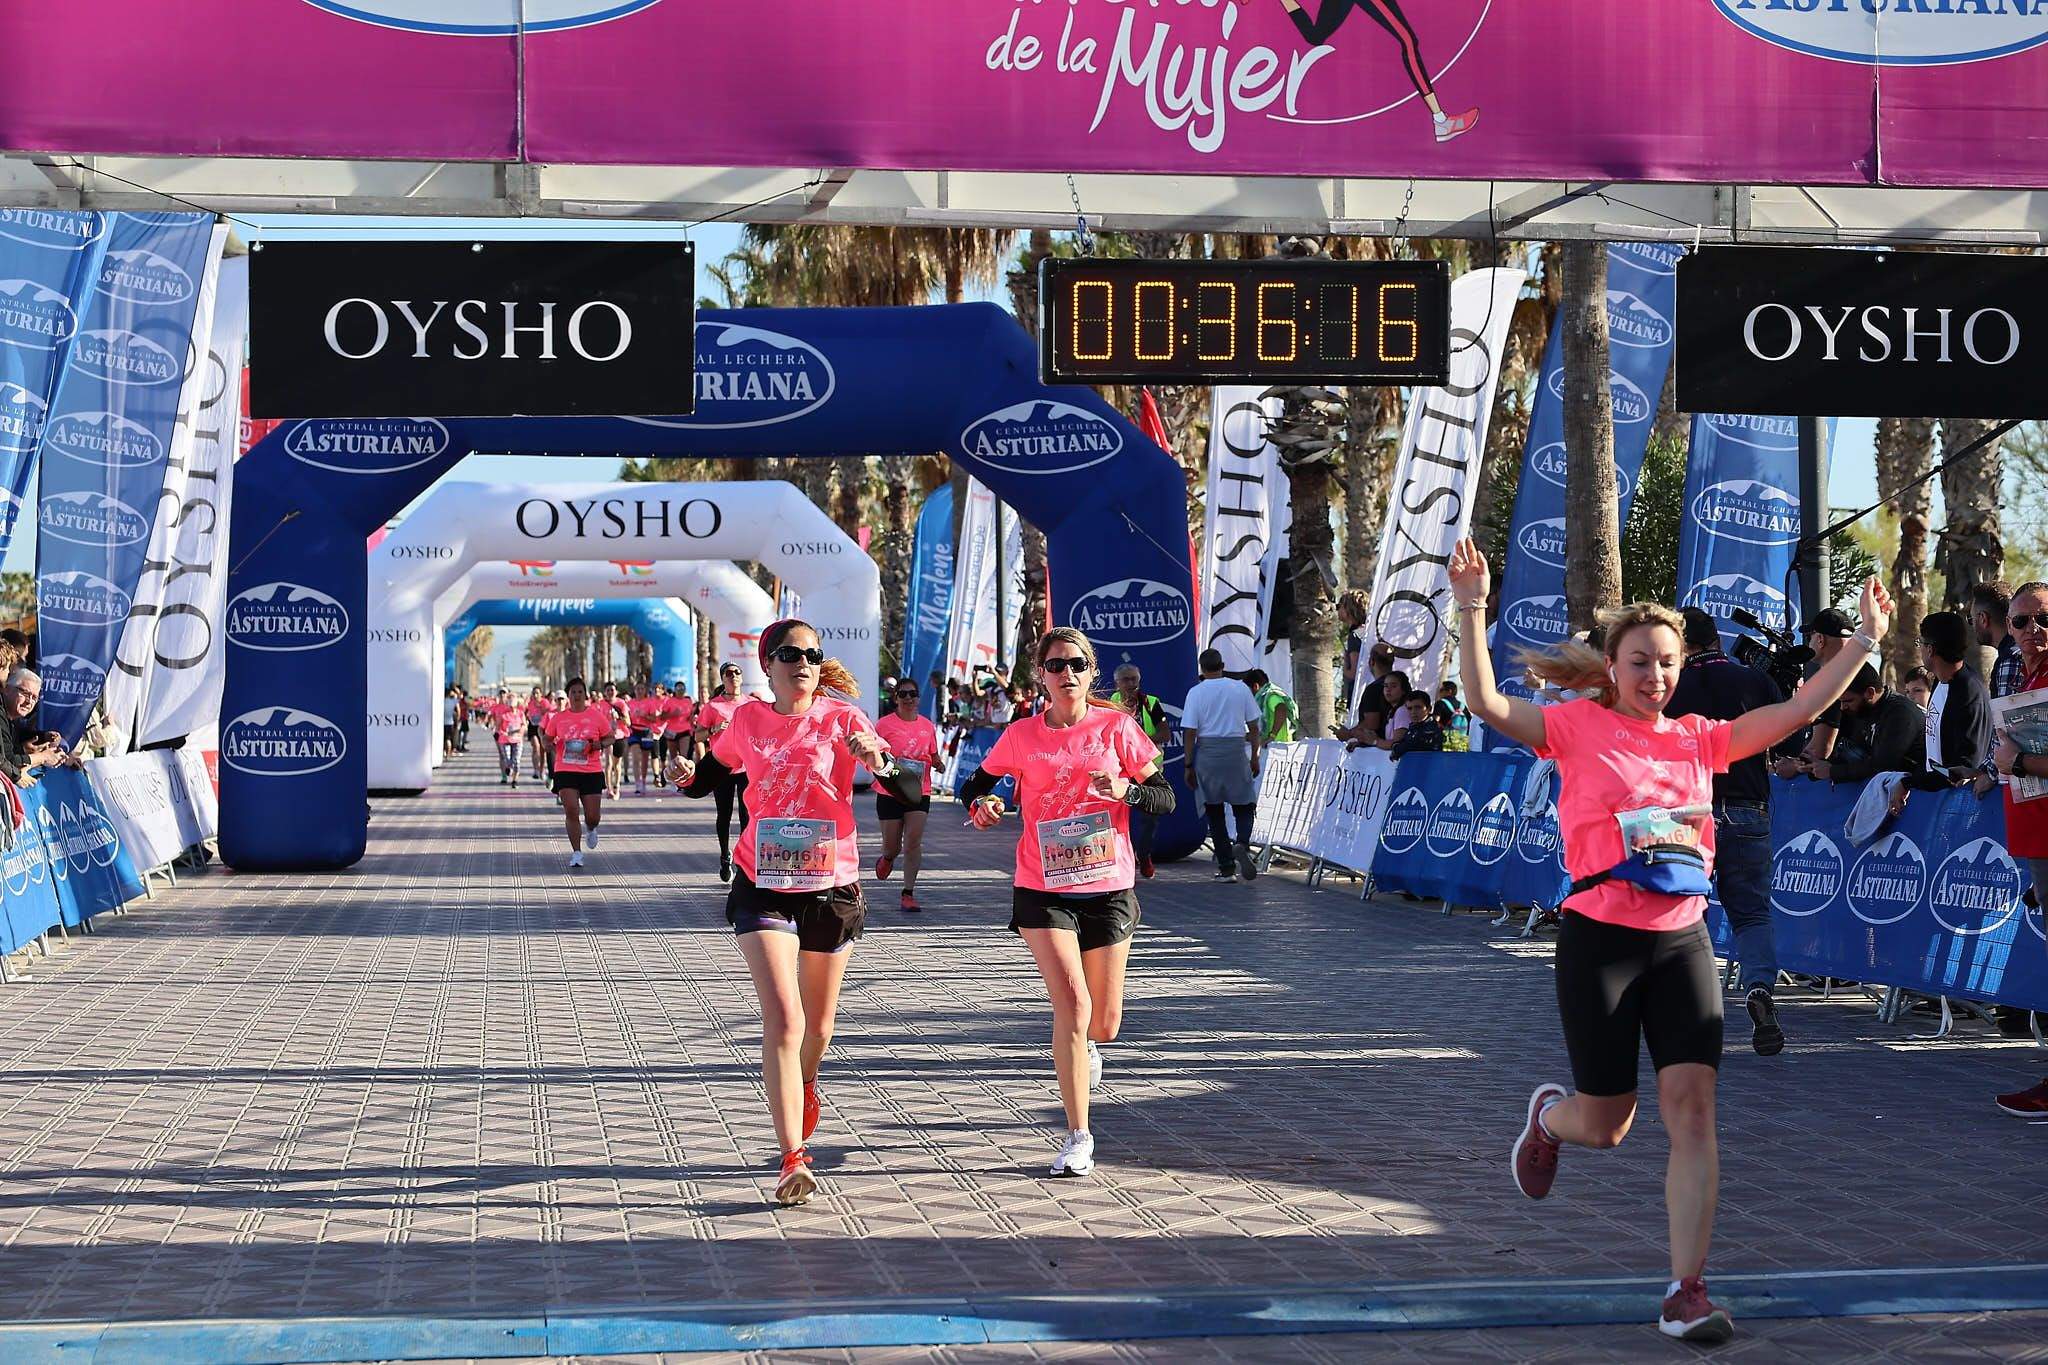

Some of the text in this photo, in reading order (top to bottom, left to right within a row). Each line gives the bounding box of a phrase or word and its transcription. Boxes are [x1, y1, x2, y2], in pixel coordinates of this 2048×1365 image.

[986, 1, 1336, 153] de la Mujer
[102, 270, 183, 297] STURIANA
[324, 298, 633, 361] OYSHO
[1073, 281, 1417, 361] 00:36:16
[1608, 313, 1663, 342] URIANA
[1743, 303, 2021, 365] OYSHO
[75, 340, 168, 378] ASTURIANA
[725, 354, 806, 365] LECHERA
[693, 371, 817, 400] RIANA
[52, 423, 153, 460] ASTURIANA
[294, 426, 437, 454] ASTURIANA
[321, 422, 433, 433] CENTRAL LECHERA
[995, 423, 1105, 435] CENTRAL LECHERA
[975, 430, 1113, 457] ASTURIANA
[1376, 328, 1491, 659] OYSHO
[1717, 495, 1758, 509] CENTRAL
[41, 504, 138, 538] ASTURIANA
[516, 498, 723, 539] OYSHO
[1699, 495, 1801, 535] ASTURIANA
[391, 545, 454, 559] OYSHO
[781, 541, 842, 556] OYSHO
[1208, 401, 1270, 680] OYSHO
[918, 543, 954, 635] Marlene
[1705, 591, 1743, 603] CENTRAL
[243, 605, 337, 615] CENTRAL LECHERA
[1079, 606, 1186, 632] ASTURIANA
[1096, 601, 1142, 611] CENTRAL
[229, 608, 341, 635] ASTURIANA
[1512, 607, 1568, 635] ASTURI
[227, 731, 338, 758] ASTURIANA
[241, 729, 334, 738] CENTRAL LECHERA
[1265, 759, 1318, 803] OYSHO
[1383, 812, 1423, 837] ASTURIANA
[1428, 812, 1469, 841] ASTURIANA
[1471, 817, 1510, 849] ASTURIANA
[781, 849, 811, 862] 016
[1064, 845, 1092, 859] 016
[1787, 857, 1811, 867] CENTRAL
[1771, 859, 1836, 896] ASTURIANA
[1850, 864, 1918, 902] ASTURIANA
[1868, 863, 1921, 876] CENTRAL LECHERA
[1953, 868, 1982, 880] CENTRAL
[1933, 870, 2011, 913] ASTURIANA
